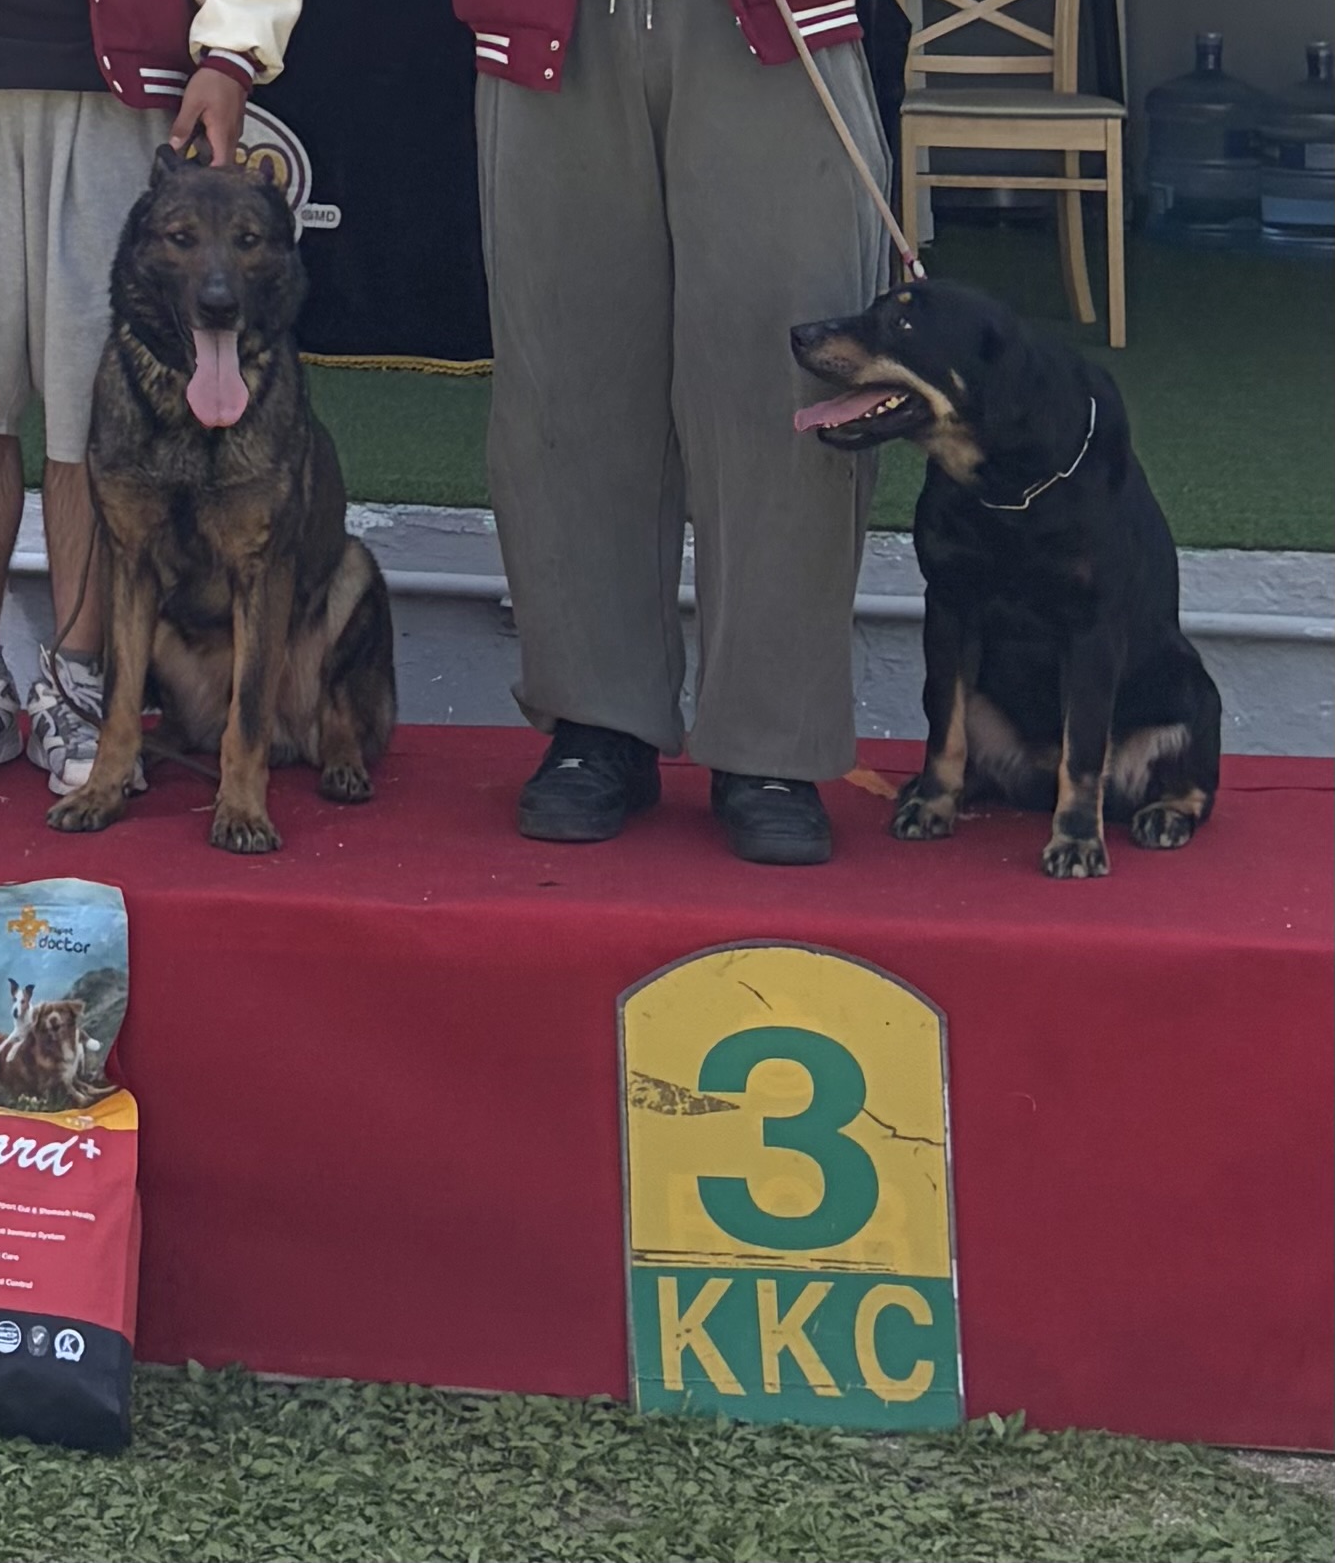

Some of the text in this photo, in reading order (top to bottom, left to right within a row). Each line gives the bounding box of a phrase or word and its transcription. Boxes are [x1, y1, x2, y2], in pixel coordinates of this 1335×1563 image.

[38, 935, 91, 954] doctor
[697, 1026, 880, 1250] 3
[657, 1275, 936, 1403] KKC
